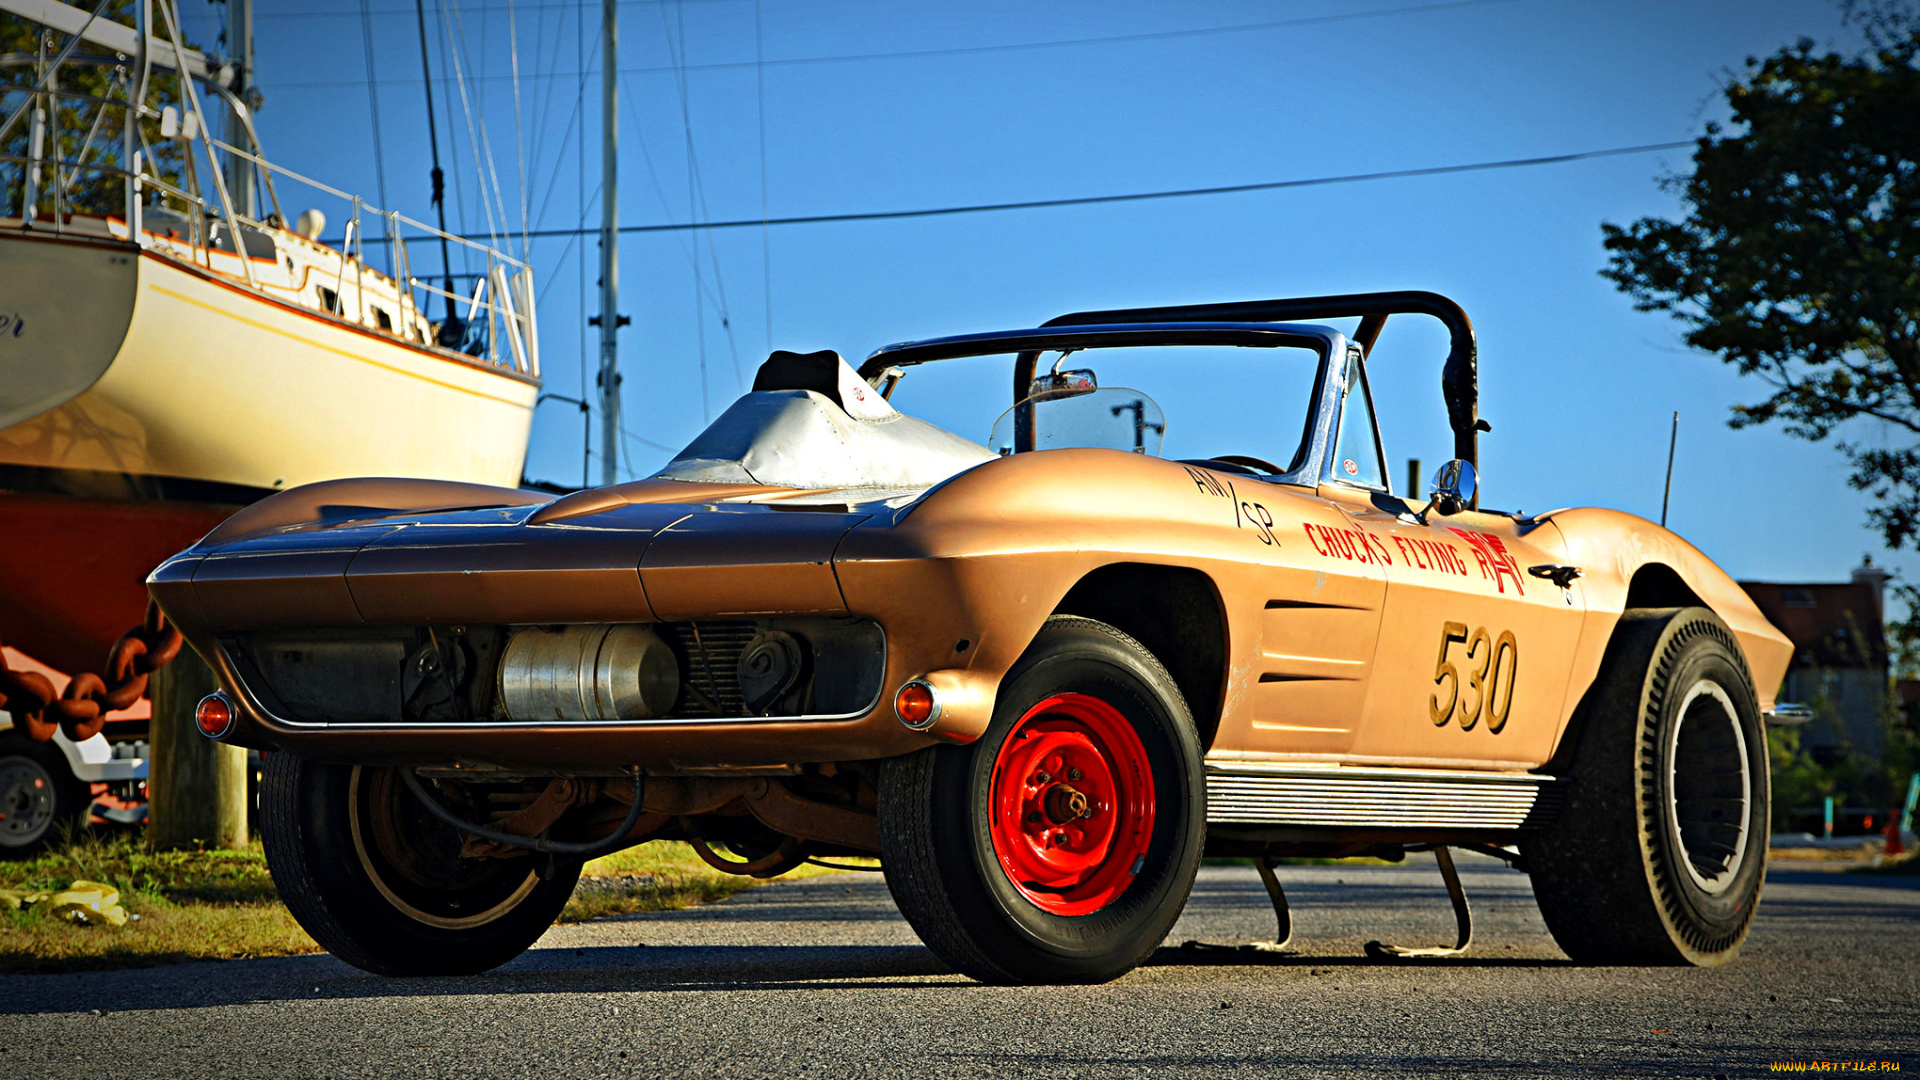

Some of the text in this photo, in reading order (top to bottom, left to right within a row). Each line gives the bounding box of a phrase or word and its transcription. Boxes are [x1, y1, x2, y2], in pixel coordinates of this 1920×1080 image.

[1303, 523, 1392, 566] CHUCK'S
[1392, 536, 1467, 576] FLYING
[1429, 621, 1517, 735] 530
